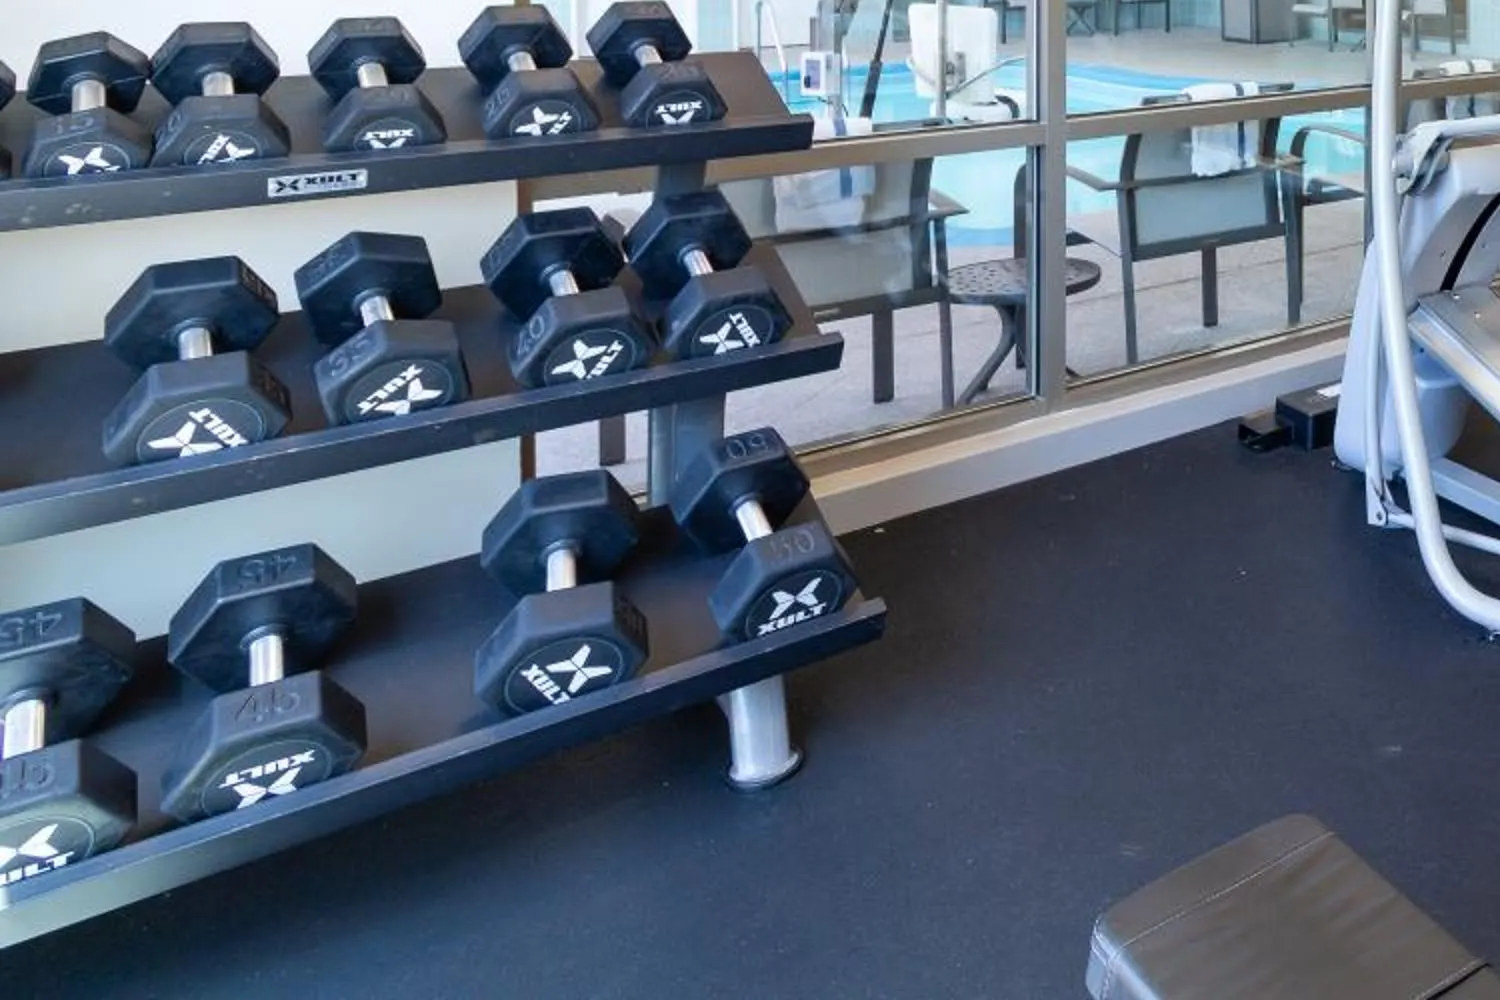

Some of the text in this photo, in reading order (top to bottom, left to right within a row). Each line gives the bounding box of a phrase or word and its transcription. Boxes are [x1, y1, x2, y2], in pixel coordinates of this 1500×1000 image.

[356, 363, 424, 415] XULT
[188, 407, 249, 449] XULT
[757, 602, 827, 637] XULT
[520, 663, 570, 705] XULT
[216, 749, 316, 789] XULT
[0, 851, 75, 886] ULT
